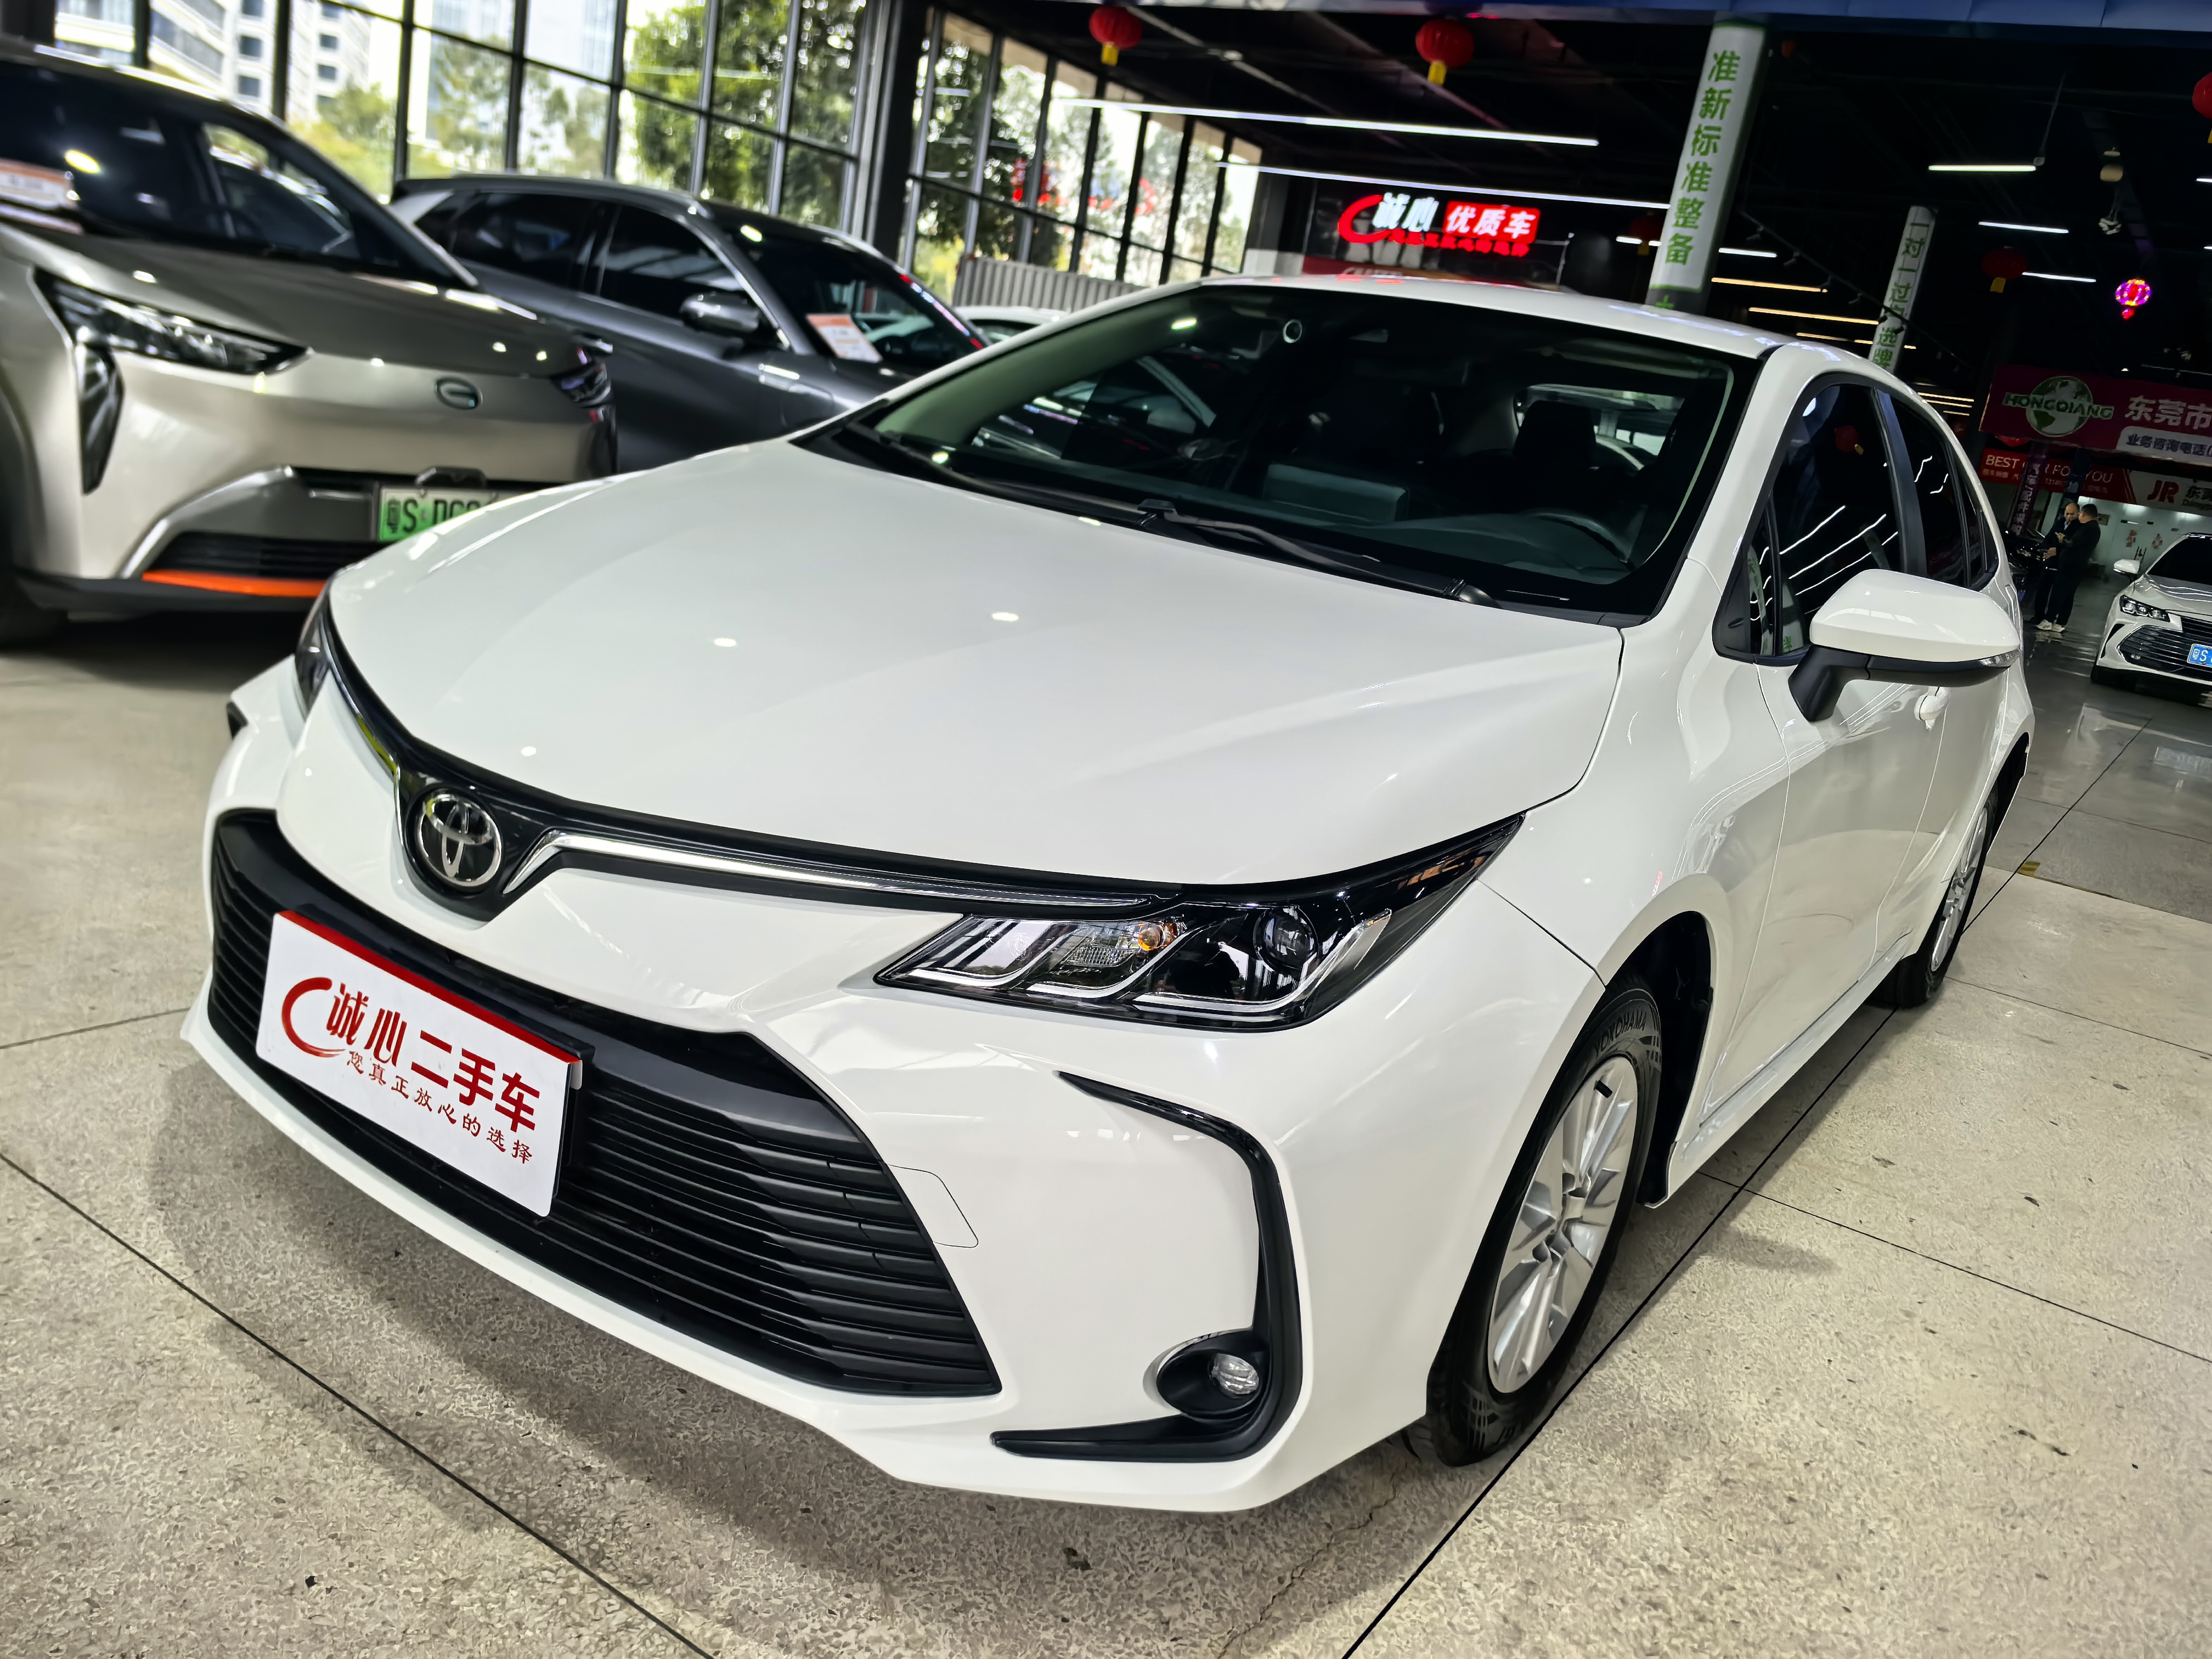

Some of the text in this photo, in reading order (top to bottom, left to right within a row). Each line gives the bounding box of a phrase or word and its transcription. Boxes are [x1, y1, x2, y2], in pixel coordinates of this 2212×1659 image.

[1664, 50, 1741, 266] 准新标准整备
[1446, 205, 1536, 239] 优质车
[2005, 394, 2113, 418] HONGQIANG
[2125, 395, 2212, 430] 东莞市
[1986, 454, 2020, 469] BEST
[2147, 480, 2179, 503] JR
[325, 982, 540, 1133] 诚心二手车
[346, 1050, 532, 1164] 您真正放心的选择
